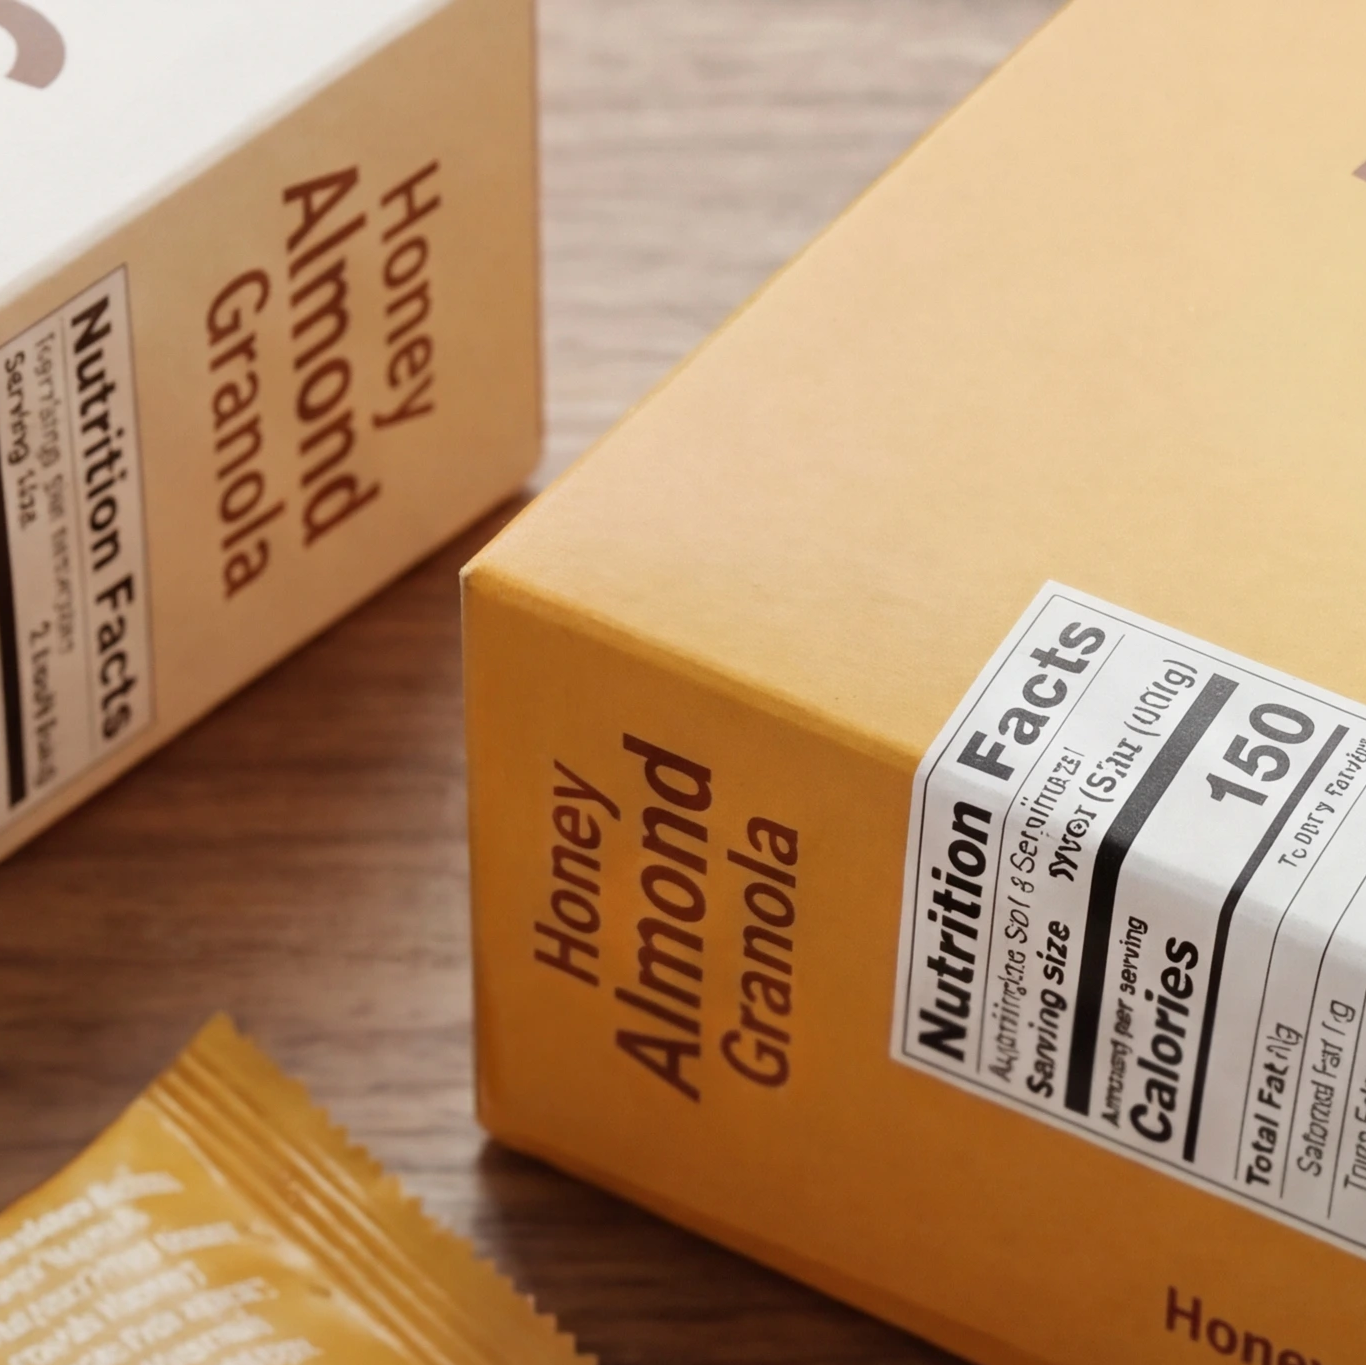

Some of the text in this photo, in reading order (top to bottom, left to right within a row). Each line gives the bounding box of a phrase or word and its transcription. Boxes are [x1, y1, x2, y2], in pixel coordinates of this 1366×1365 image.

[206, 268, 287, 602] Granola
[283, 166, 382, 550] Almond
[372, 160, 442, 431] Honey
[69, 293, 139, 743] Nutrition Facts
[534, 759, 621, 988] Honey
[614, 732, 713, 1104] Almond
[720, 816, 799, 1089] Granola
[916, 621, 1107, 1064] Nutrition Facts
[1127, 702, 1316, 1145] Calories 150
[1244, 1112, 1280, 1187] Total
